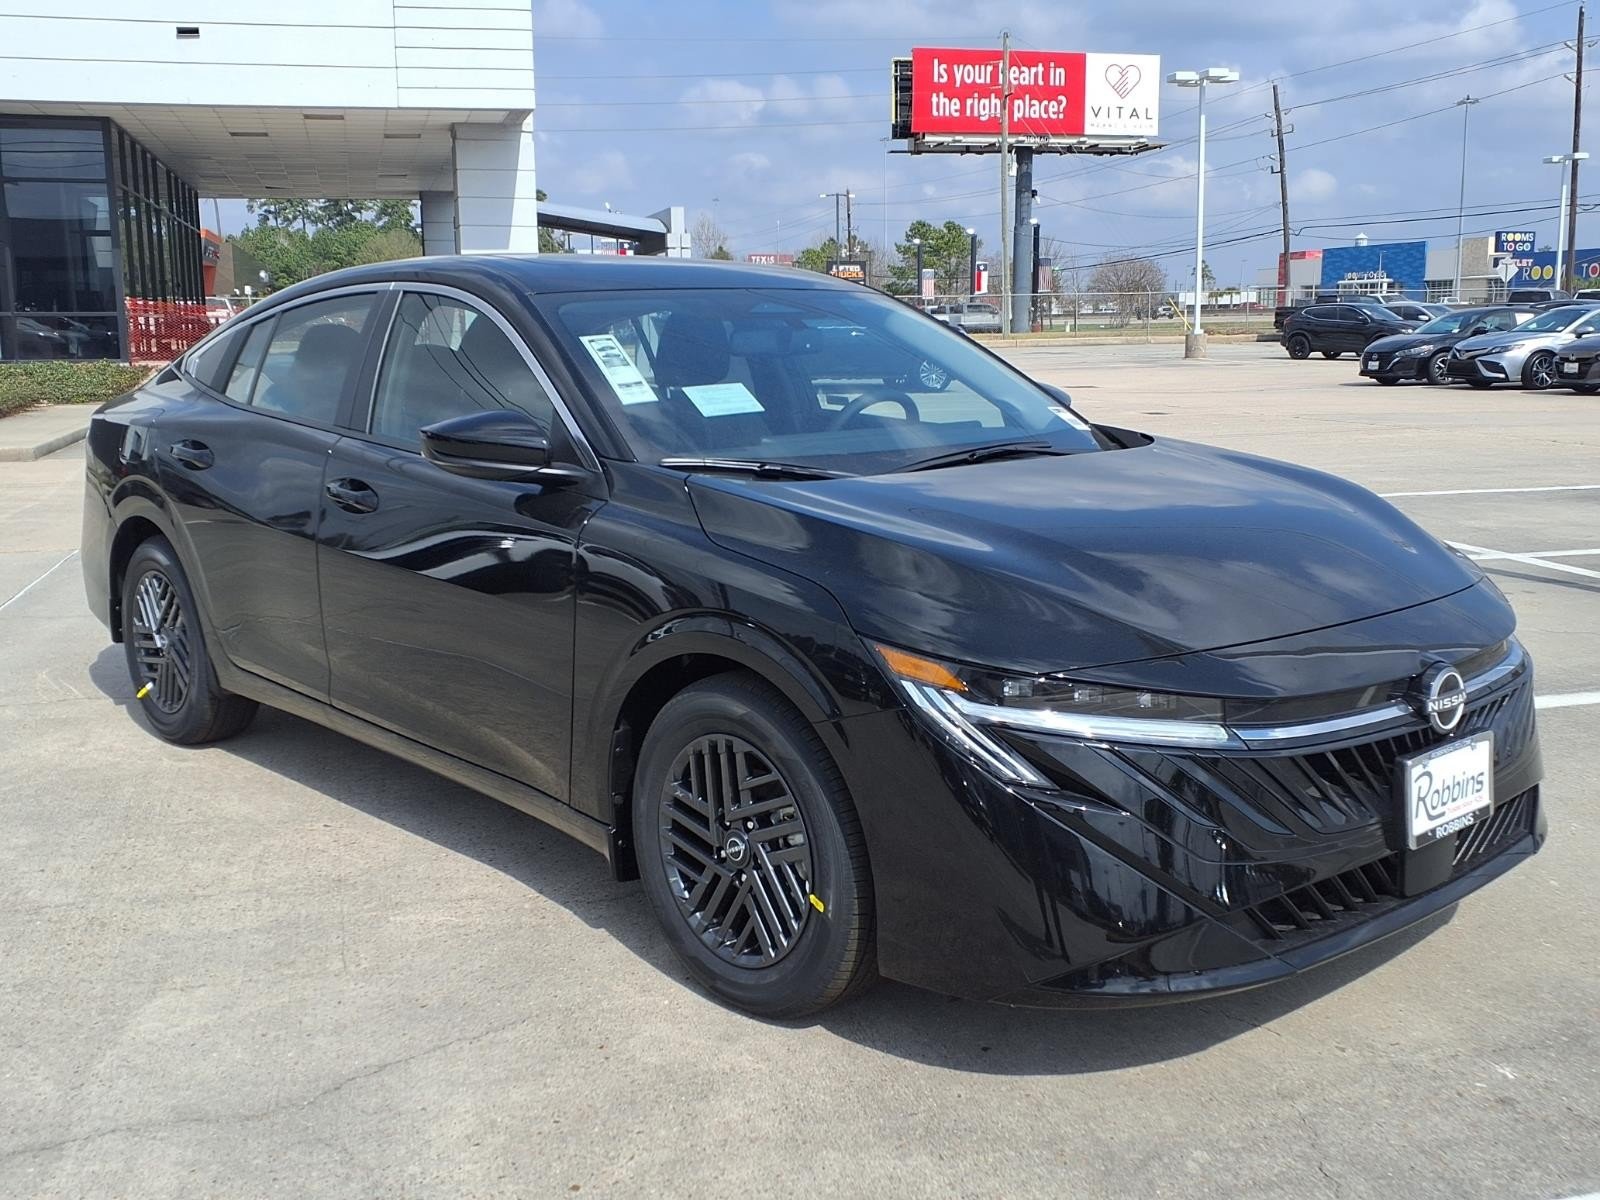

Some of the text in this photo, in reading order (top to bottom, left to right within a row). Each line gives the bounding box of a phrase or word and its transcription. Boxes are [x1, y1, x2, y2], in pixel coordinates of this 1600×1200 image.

[933, 58, 948, 83] Is
[953, 64, 993, 88] your
[1049, 61, 1066, 86] in
[931, 91, 1068, 122] the righ place?
[1091, 105, 1153, 120] VITAL
[1501, 232, 1534, 242] ROOMS
[1503, 242, 1531, 251] TO GO
[1428, 691, 1467, 712] NISSAN
[1414, 770, 1484, 821] Robbins
[1436, 812, 1475, 839] ROBBINS
